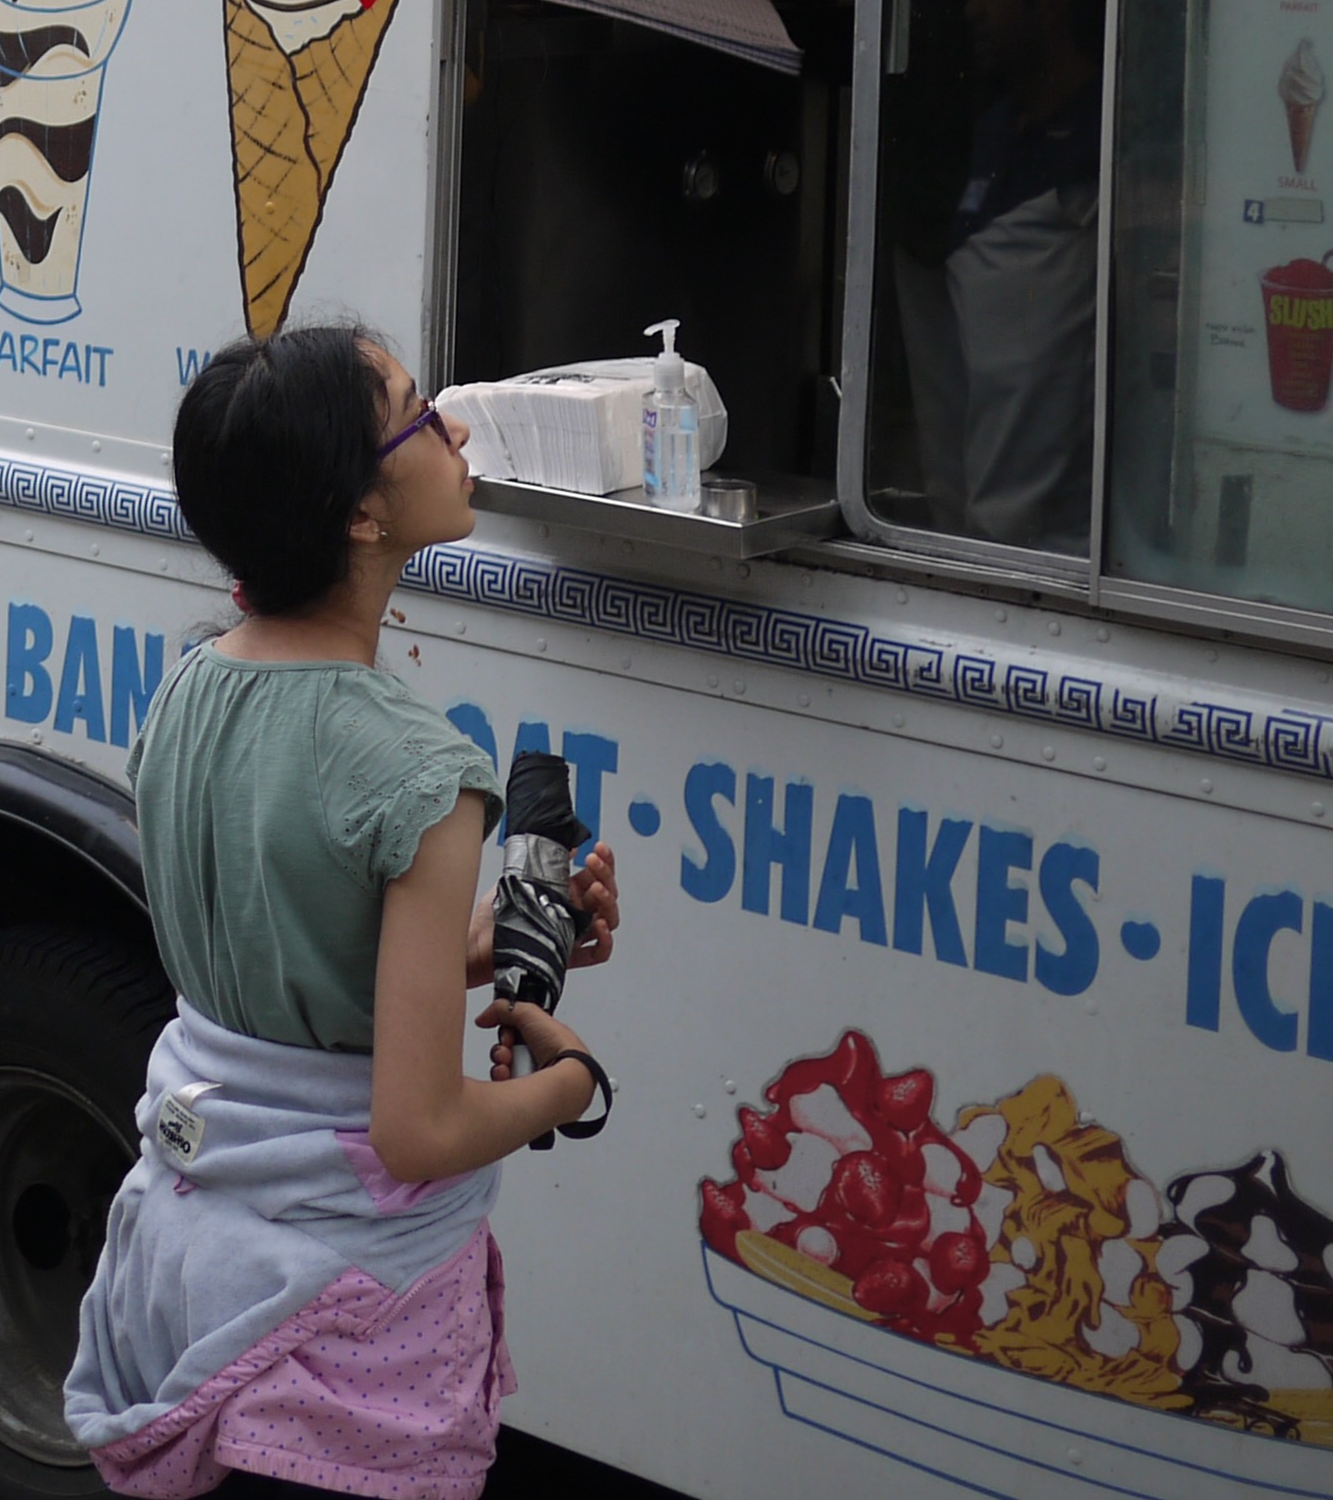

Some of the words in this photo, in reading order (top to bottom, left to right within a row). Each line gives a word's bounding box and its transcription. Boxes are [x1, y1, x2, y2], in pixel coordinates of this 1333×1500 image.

[1277, 176, 1317, 191] SMALL
[5, 599, 201, 749] BAN
[680, 759, 1100, 997] SHAKES
